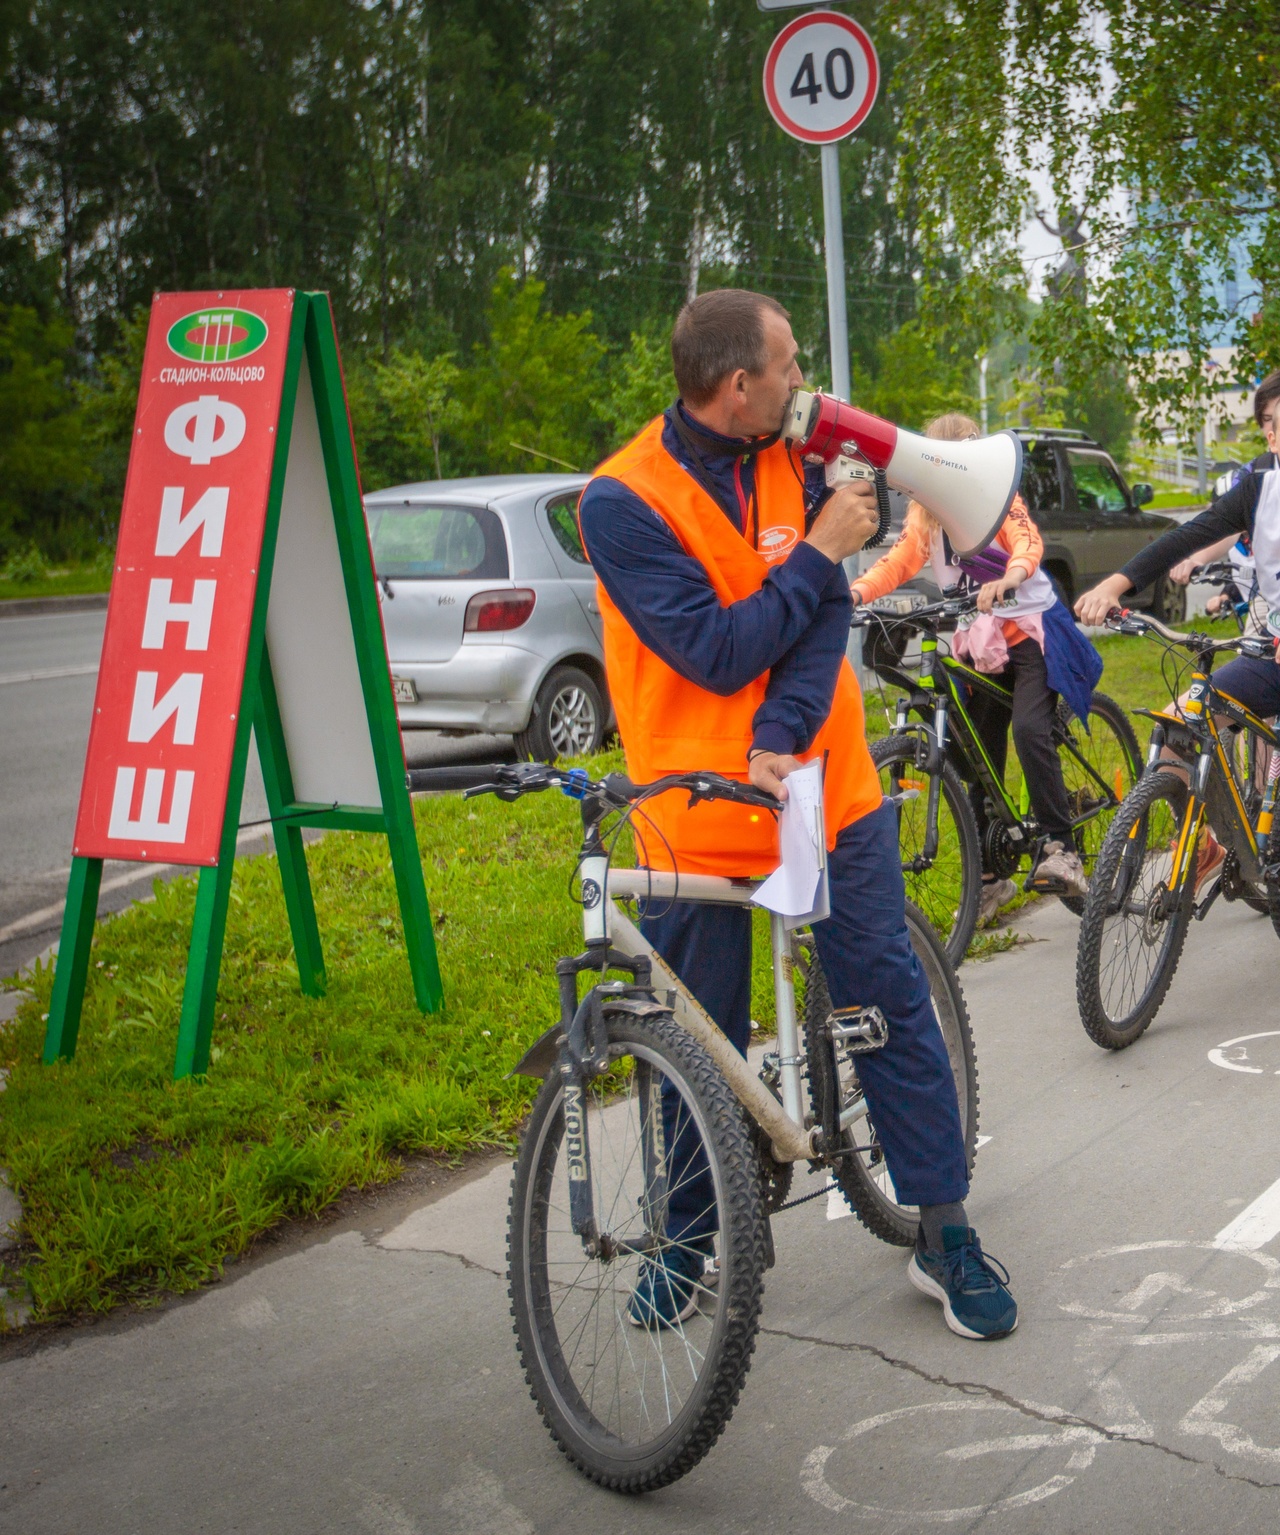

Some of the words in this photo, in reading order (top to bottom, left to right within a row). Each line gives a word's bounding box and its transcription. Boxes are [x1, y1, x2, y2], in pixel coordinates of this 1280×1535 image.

[789, 47, 855, 105] 40
[160, 365, 265, 387] СТАДИОН-КОЛЬЦОВО
[920, 452, 968, 472] ГОВОРИТЕЛЬ
[107, 395, 247, 844] ФИНИШ
